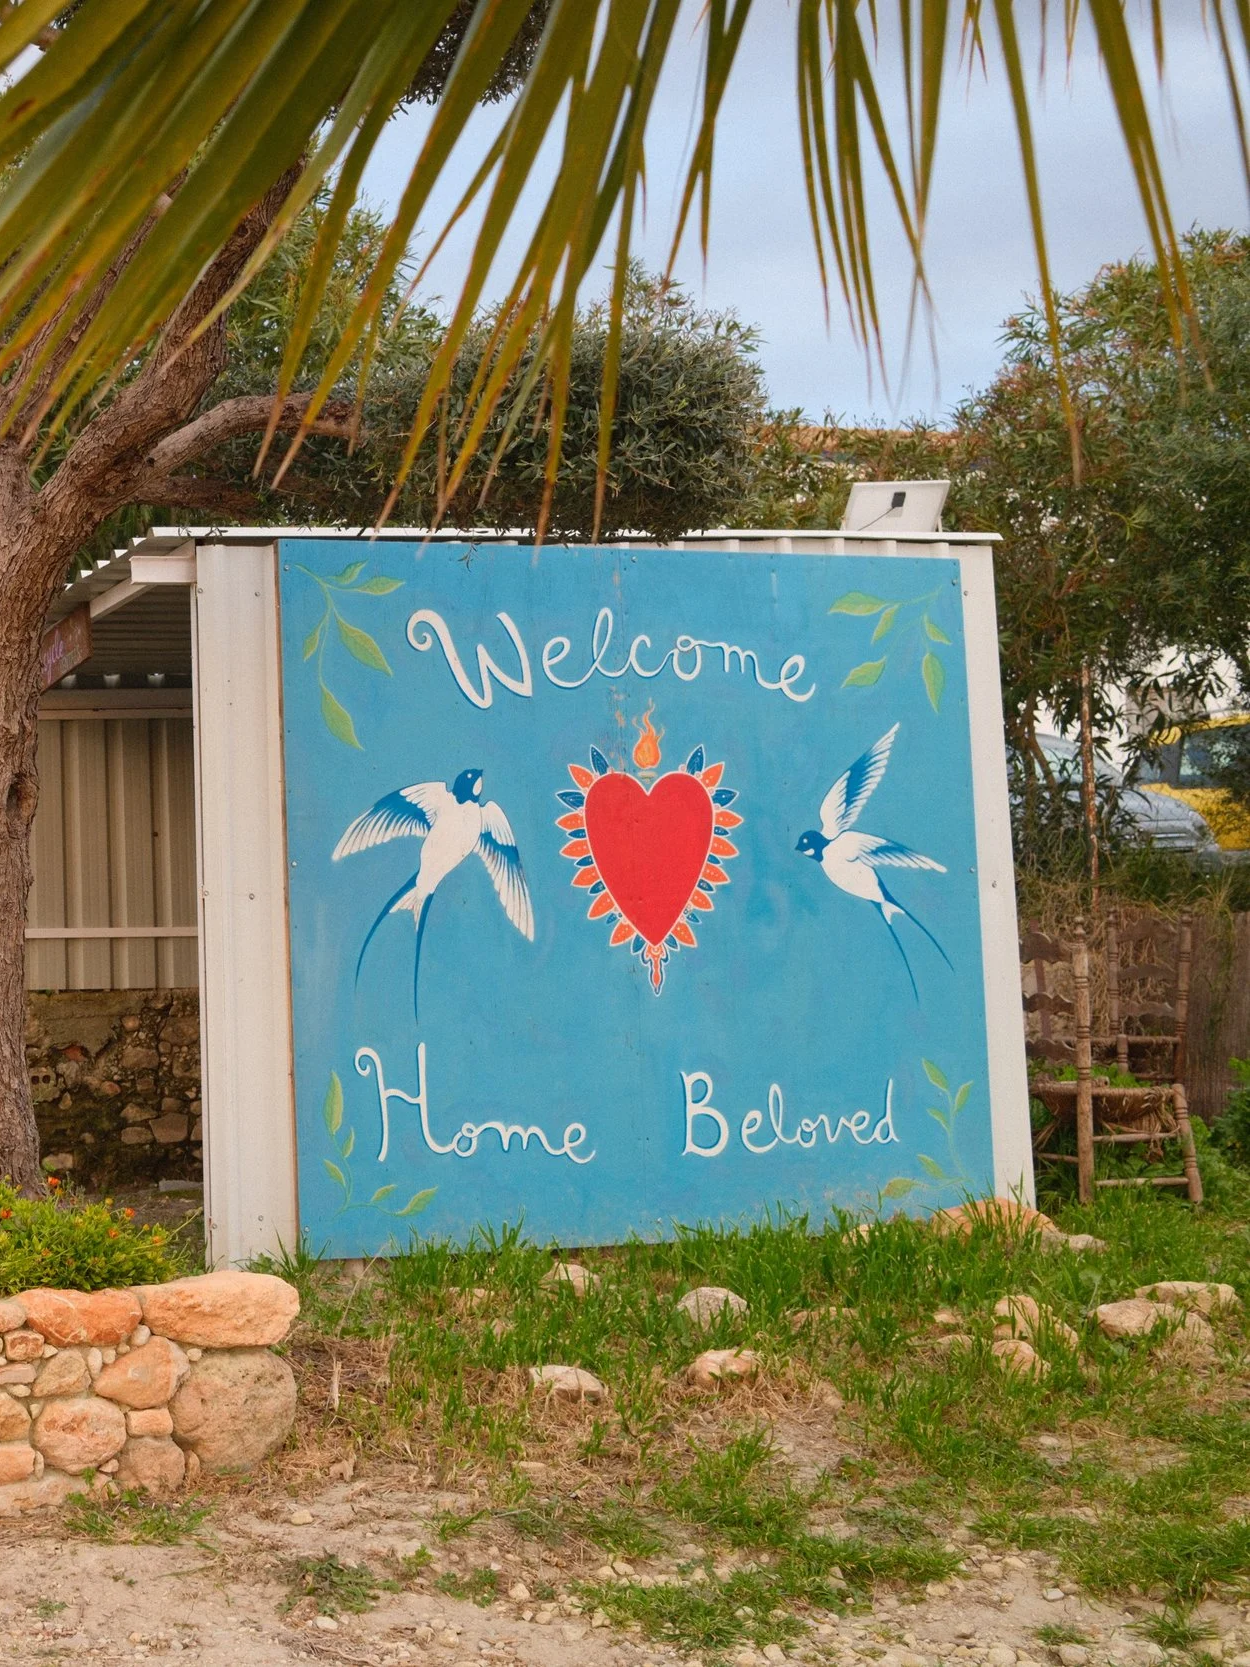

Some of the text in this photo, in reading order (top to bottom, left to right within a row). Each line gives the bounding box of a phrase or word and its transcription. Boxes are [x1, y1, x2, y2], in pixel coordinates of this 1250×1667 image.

[406, 608, 816, 710] Welcome
[355, 1042, 899, 1164] Home Beloved
